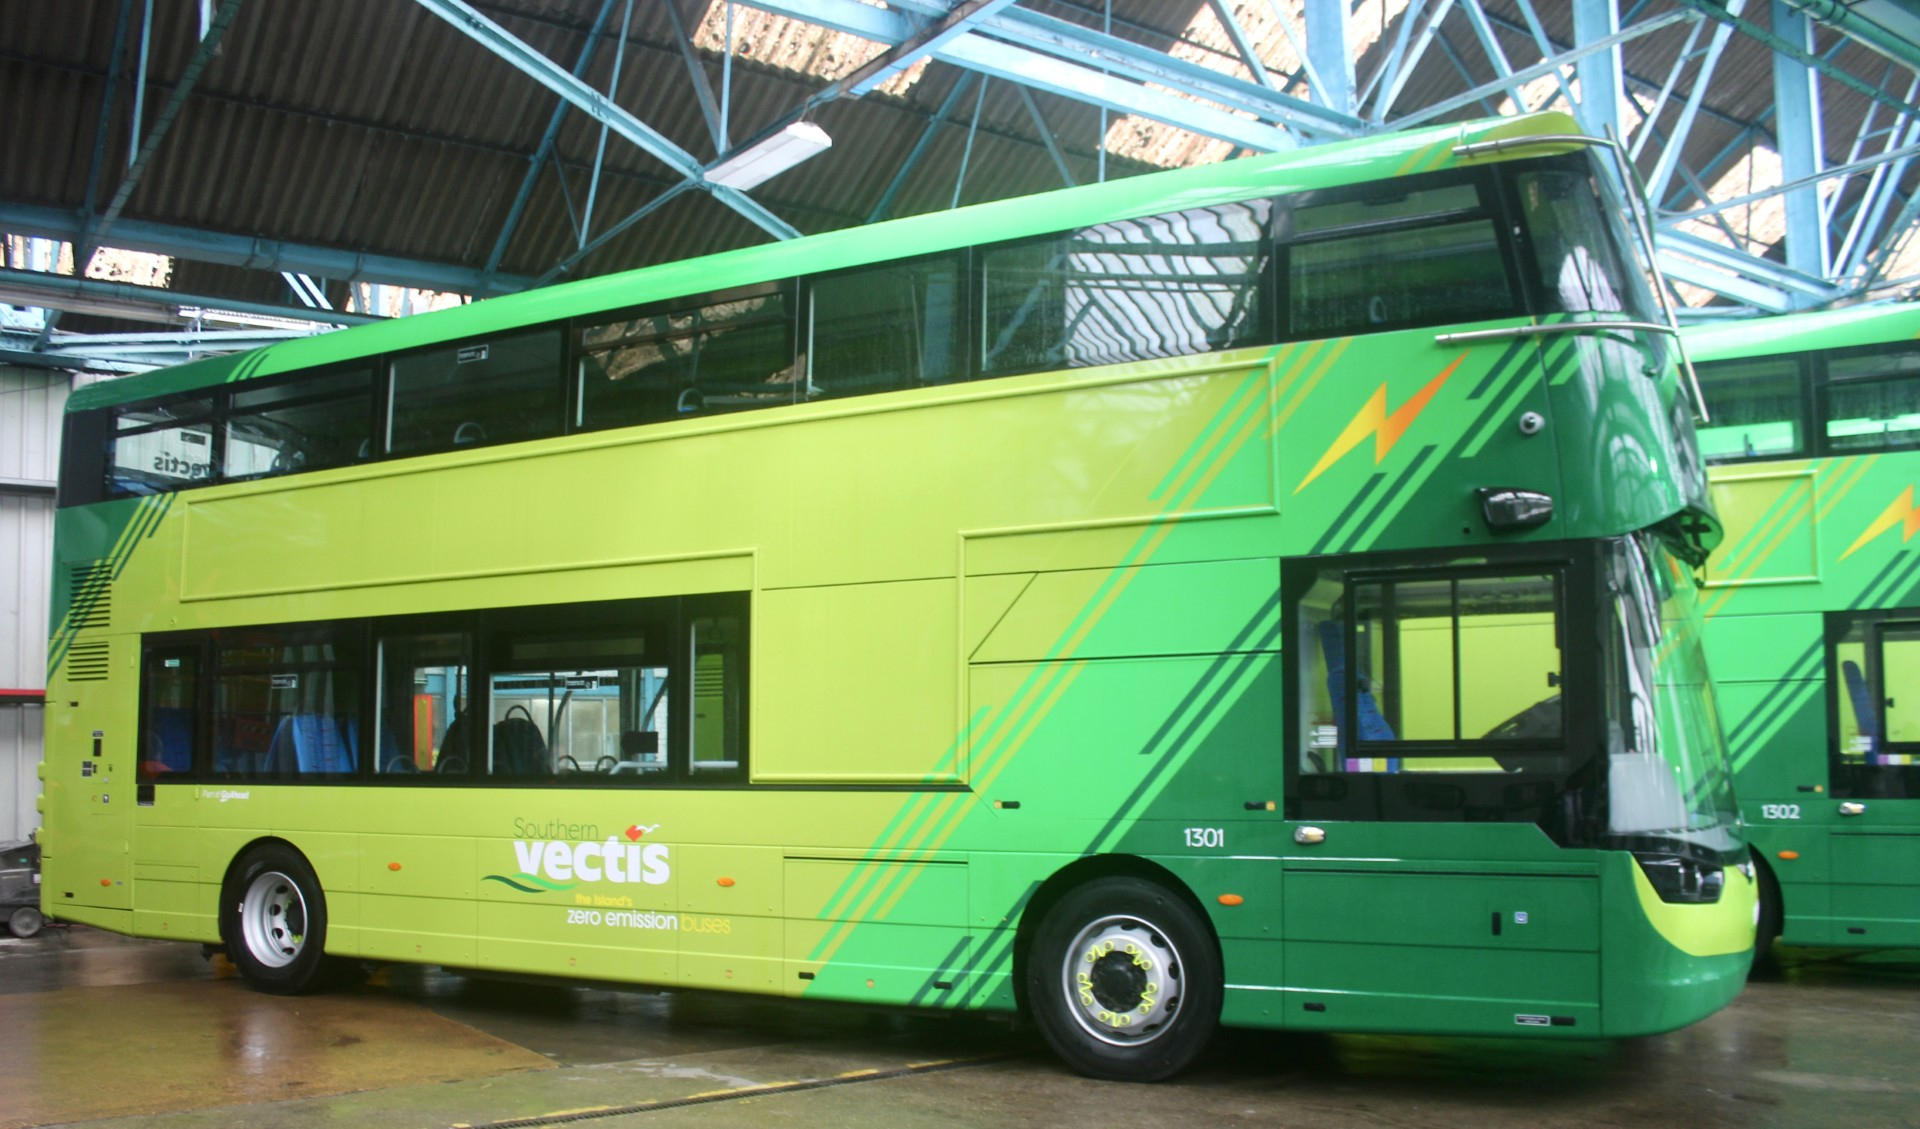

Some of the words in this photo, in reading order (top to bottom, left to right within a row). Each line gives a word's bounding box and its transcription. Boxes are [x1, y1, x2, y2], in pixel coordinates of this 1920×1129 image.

[1761, 804, 1800, 819] 1302
[513, 817, 599, 840] Southern
[1183, 827, 1224, 848] 1301
[513, 835, 670, 885] vectis
[575, 893, 592, 905] the
[567, 909, 602, 926] zero
[605, 910, 678, 931] emission
[681, 913, 731, 934] buses
